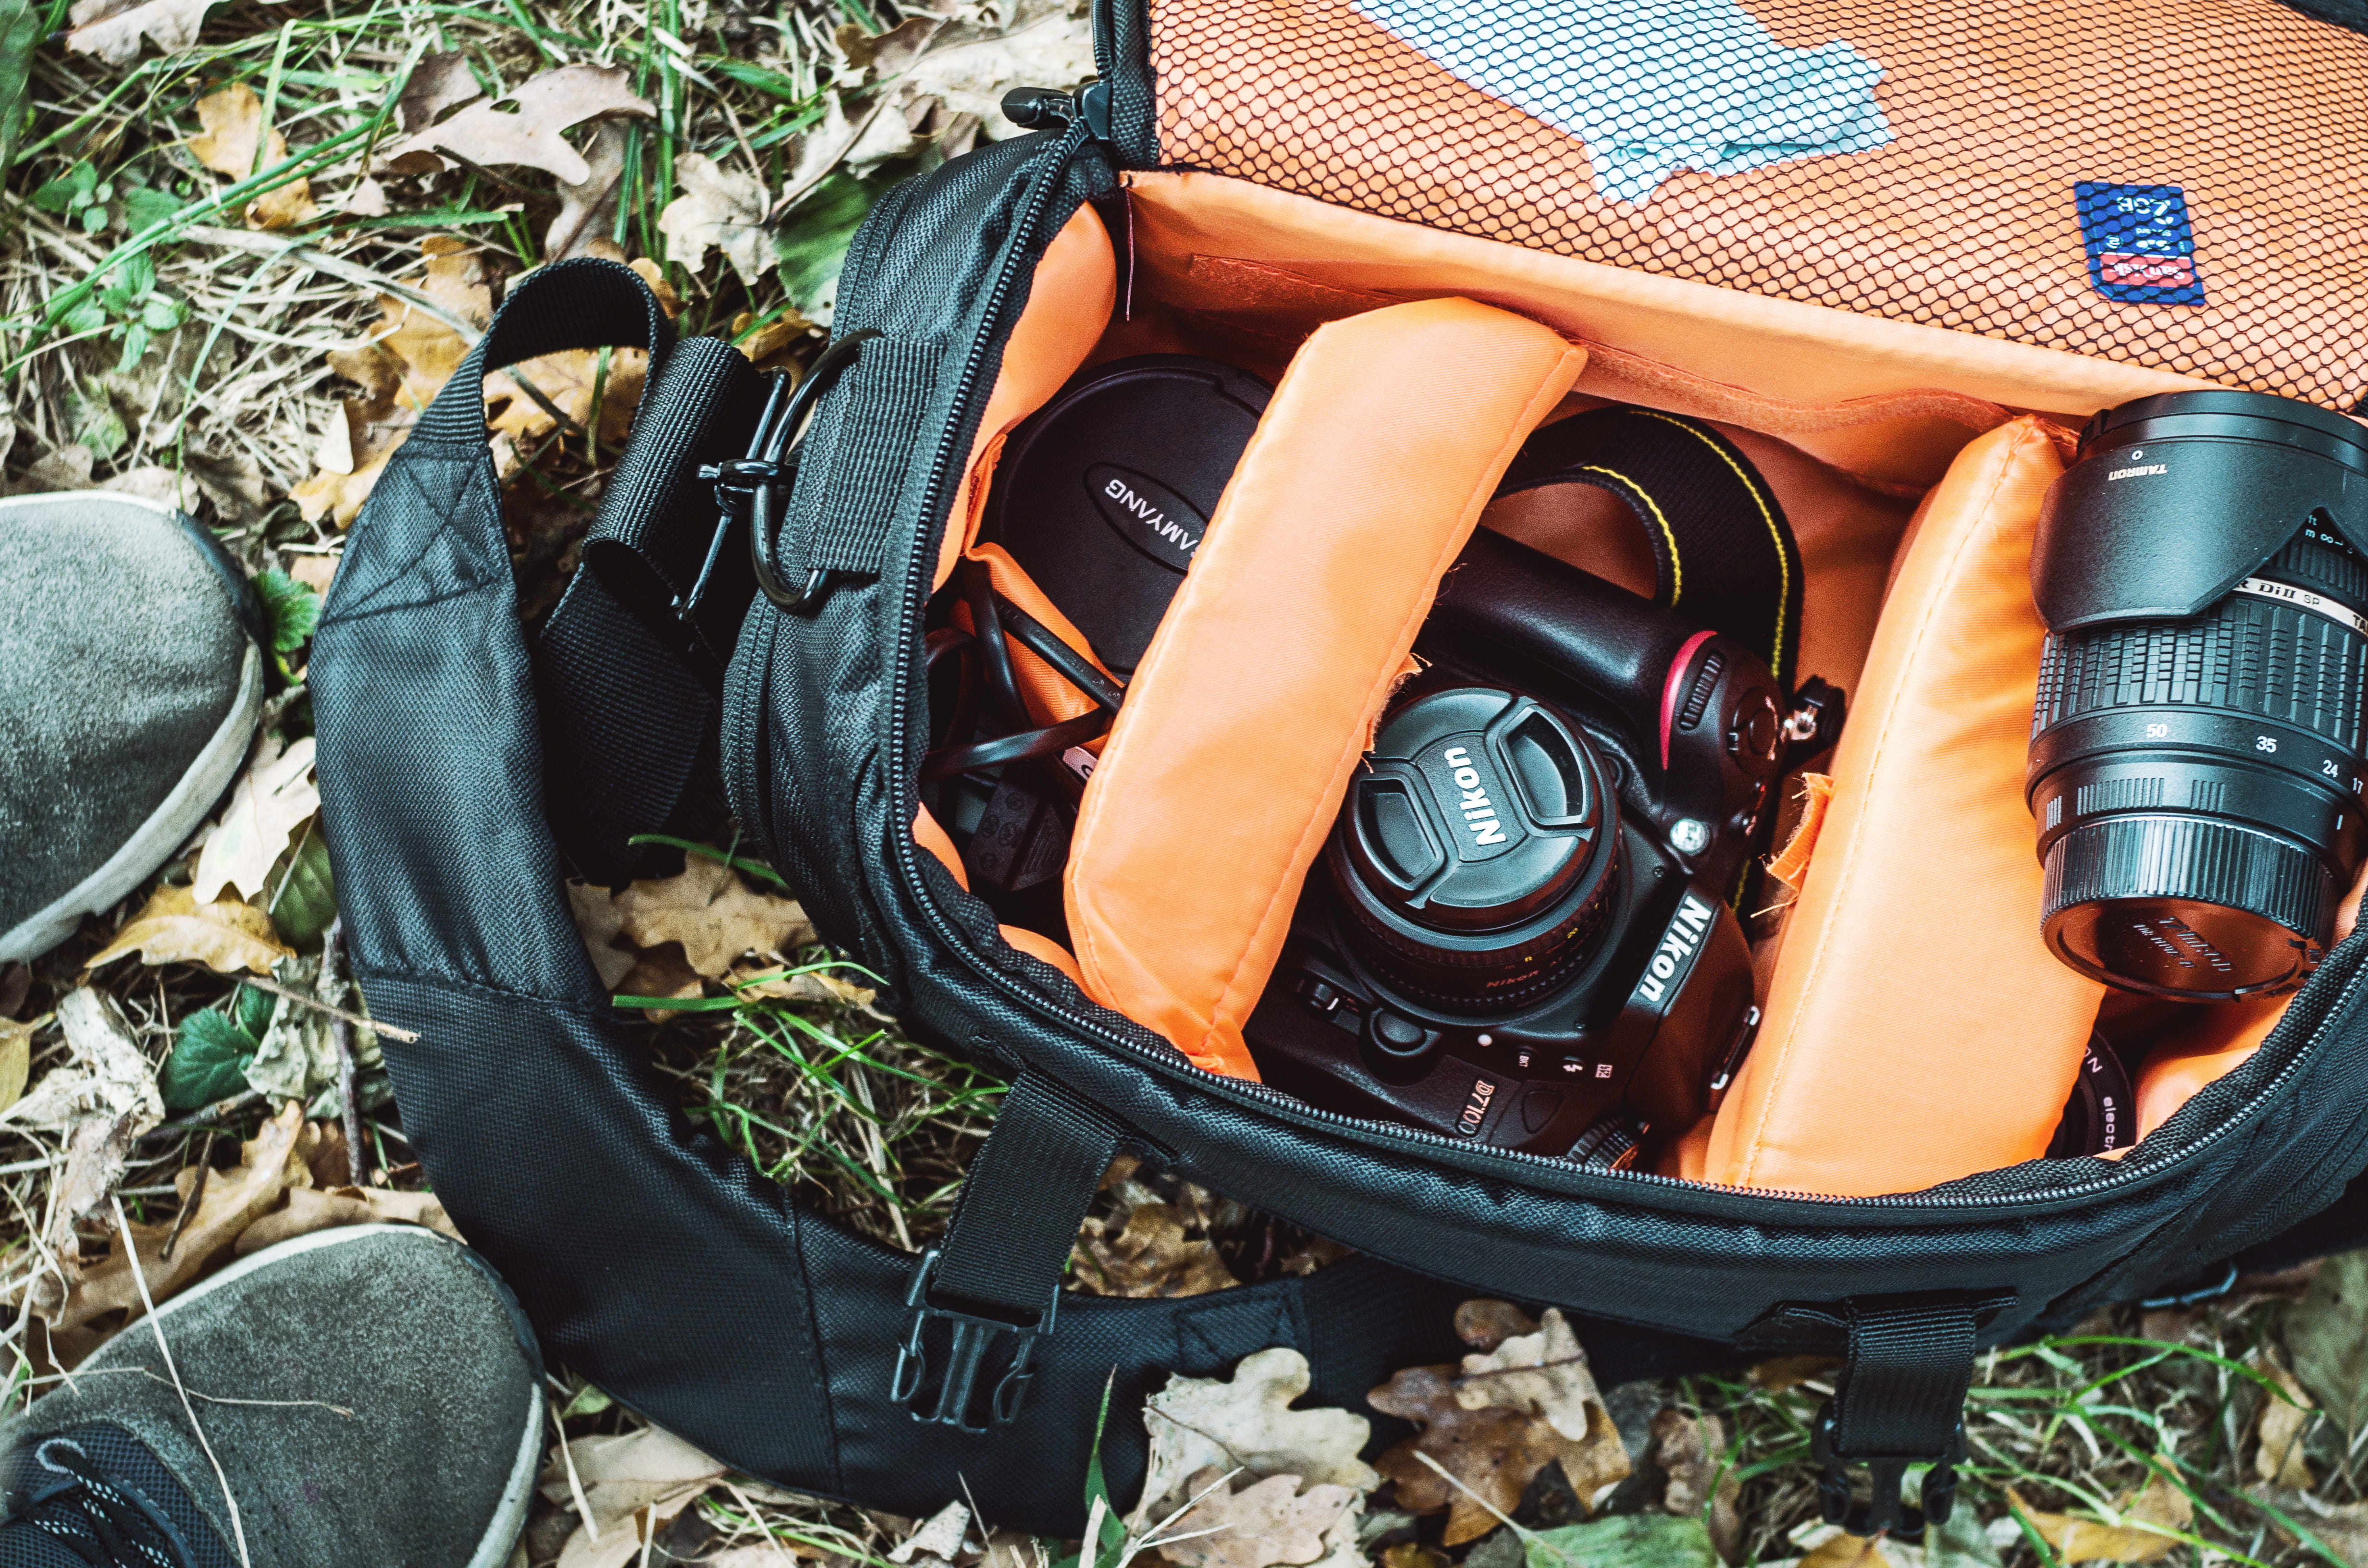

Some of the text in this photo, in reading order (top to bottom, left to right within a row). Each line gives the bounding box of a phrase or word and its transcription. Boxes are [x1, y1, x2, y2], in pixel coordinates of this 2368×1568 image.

[2108, 464, 2168, 481] TAMRON
[1105, 479, 1201, 557] AMYANG
[2308, 514, 2318, 526] ft
[2304, 594, 2320, 605] SP
[2353, 614, 2368, 633] TA
[2146, 723, 2364, 795] 50 35 24 17
[1443, 747, 1506, 846] Nikon
[1639, 895, 1712, 1002] Nikon
[1518, 1055, 1529, 1068] BKT
[1459, 1080, 1495, 1135] D7100
